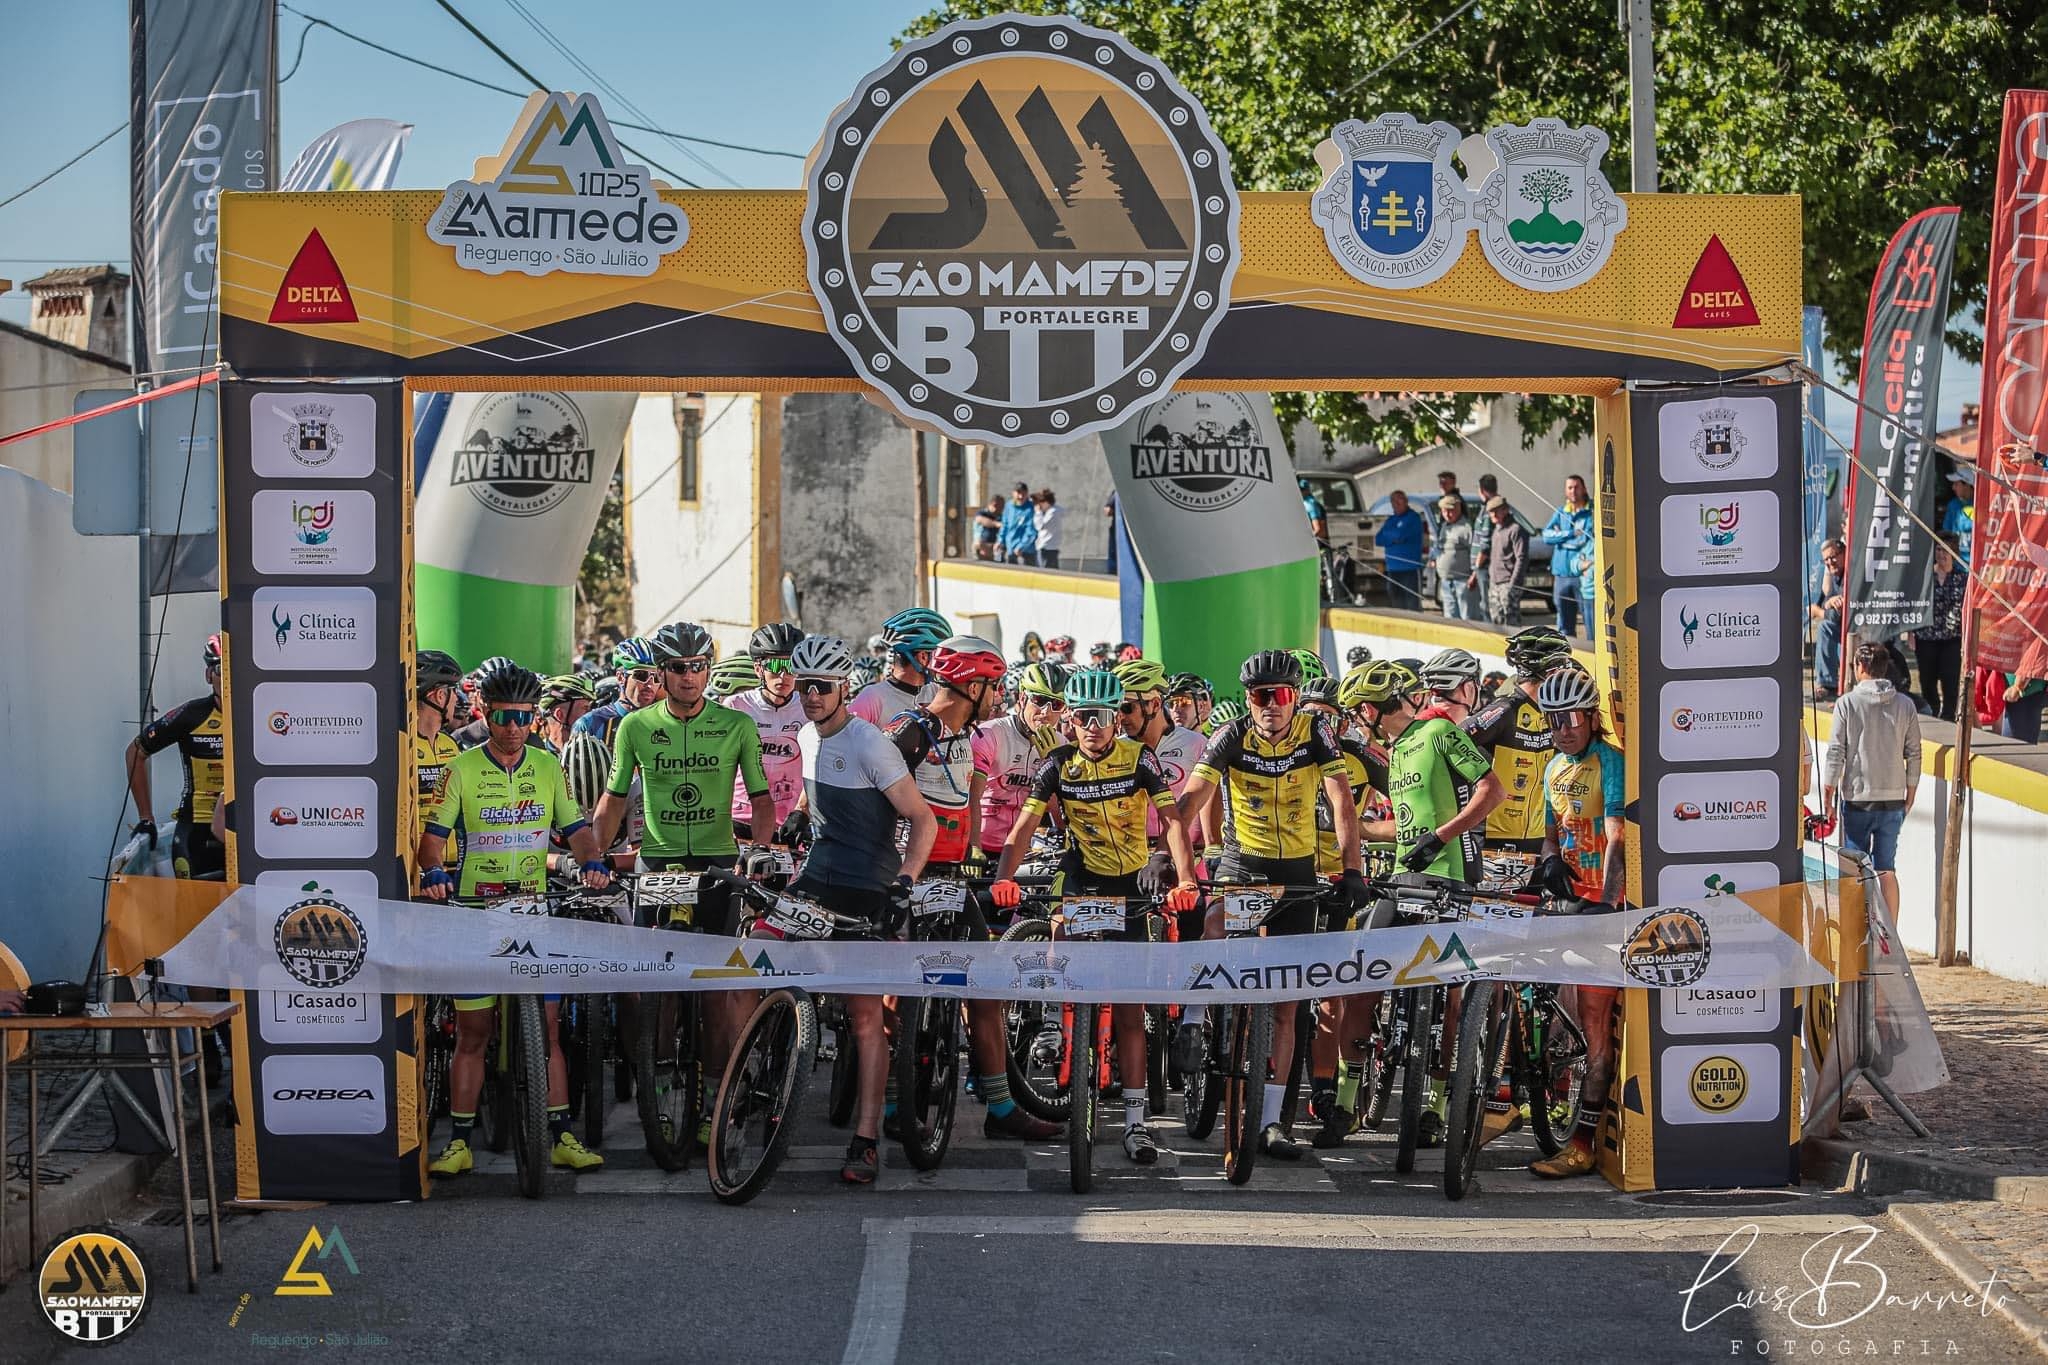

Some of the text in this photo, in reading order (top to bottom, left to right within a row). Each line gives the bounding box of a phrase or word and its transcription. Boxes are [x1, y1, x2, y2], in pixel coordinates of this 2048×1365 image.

[578, 172, 641, 197] 1025
[442, 192, 678, 244] Mamede
[464, 244, 648, 267] Reguengo São Julião
[1497, 247, 1532, 275] JULIÃO
[1541, 239, 1599, 278] PORTALEGRE
[863, 260, 1189, 297] SÃO MAMEDE
[287, 286, 343, 303] DELTA
[1690, 291, 1745, 308] DELTA
[999, 311, 1139, 325] PORTALEGRE
[897, 306, 1149, 402] BTT
[453, 451, 590, 484] AVENTURA
[1135, 447, 1271, 480] AVENTURA
[488, 493, 551, 510] PORTALEGRE
[1169, 489, 1233, 505] PORTALEGRE
[292, 500, 334, 529] ipdj
[1700, 502, 1739, 530] ipdj
[299, 614, 355, 629] Clínica
[1706, 612, 1760, 627] Clínica
[299, 630, 357, 640] Sta Beatriz
[1705, 627, 1761, 639] Sta Beatriz
[289, 717, 363, 727] PORTEVIDRO
[1692, 710, 1763, 722] PORTEVIDRO
[653, 752, 719, 772] fundão
[302, 807, 365, 820] UNICAR
[660, 807, 716, 821] create
[1705, 800, 1767, 814] UNICAR
[479, 831, 533, 846] onebike
[1397, 826, 1429, 842] eate
[1494, 863, 1529, 876] 317
[645, 876, 692, 886] 292
[1484, 906, 1524, 918] 166
[293, 958, 349, 982] BTT
[510, 961, 589, 978] Reguengo
[599, 960, 628, 973] São
[1189, 950, 1393, 990] Mamede
[1639, 963, 1696, 983] BTT
[288, 994, 357, 1008] JCasado
[1696, 1006, 1745, 1016] COSMÉTICOS
[297, 1014, 345, 1024] COSMÉTICOS
[1700, 1068, 1737, 1082] GOLD
[1696, 1081, 1741, 1092] NUTRITION
[273, 1089, 375, 1101] ORBEA
